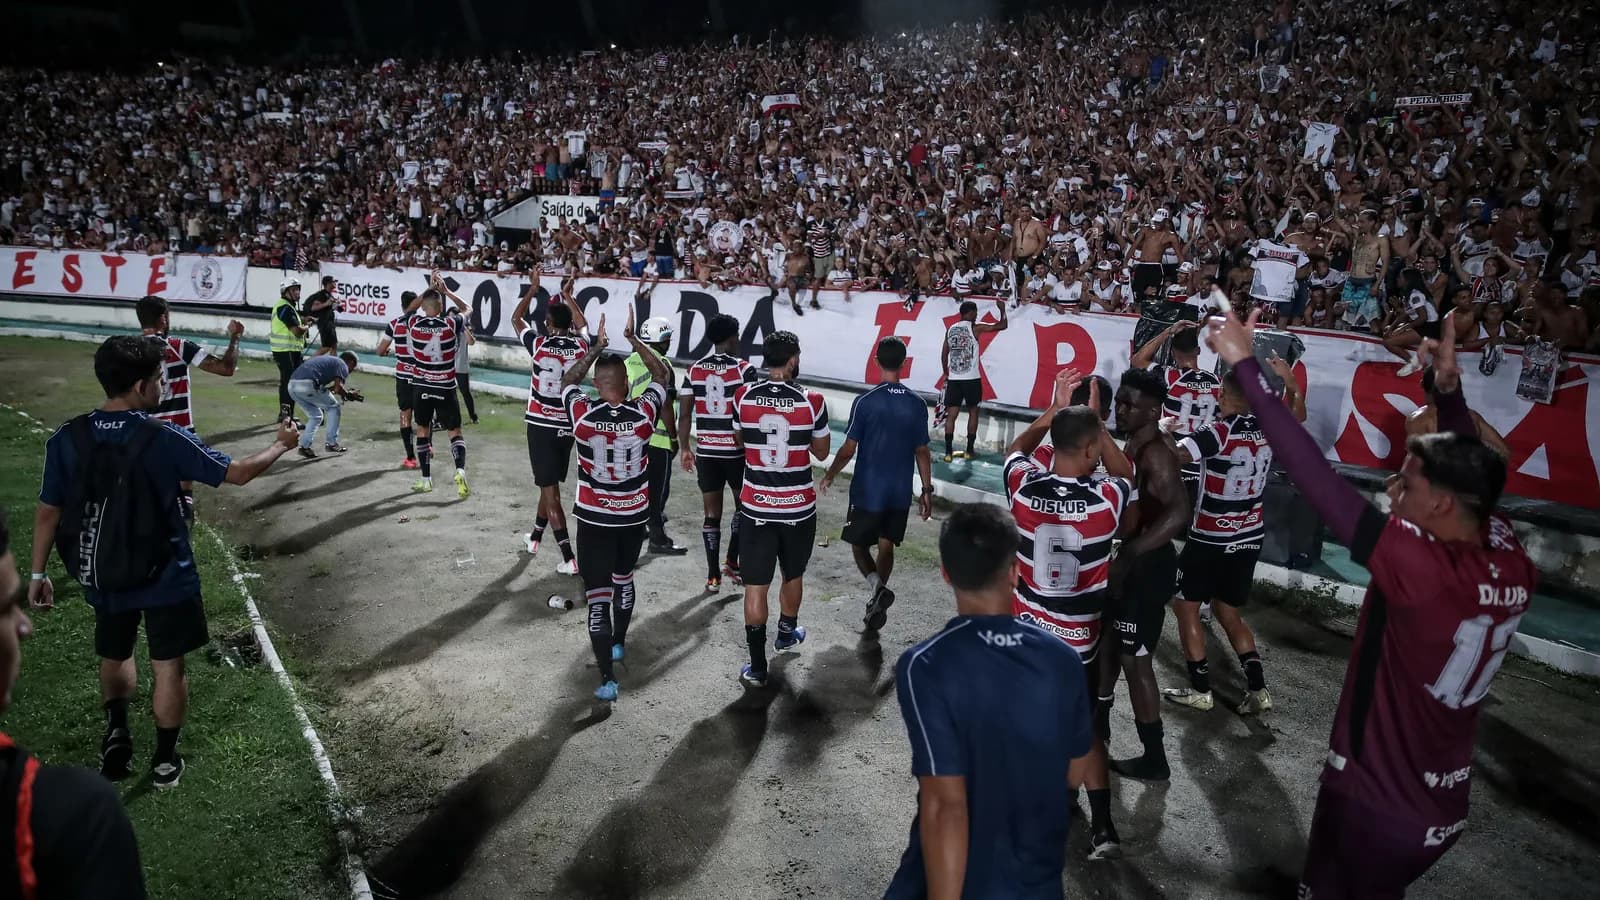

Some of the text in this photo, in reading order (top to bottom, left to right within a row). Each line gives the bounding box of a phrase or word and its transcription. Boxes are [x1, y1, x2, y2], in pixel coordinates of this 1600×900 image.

[541, 200, 574, 216] Saída
[13, 251, 168, 296] ESTE
[335, 281, 390, 299] sportes
[423, 334, 444, 362] 4
[705, 373, 727, 413] 8
[756, 396, 794, 408] DISLUB
[595, 422, 634, 432] DISLUB
[758, 413, 790, 467] 3
[587, 433, 645, 479] 10
[1030, 496, 1087, 514] DISLUB
[1033, 523, 1083, 591] 6
[977, 629, 1024, 647] VOLT
